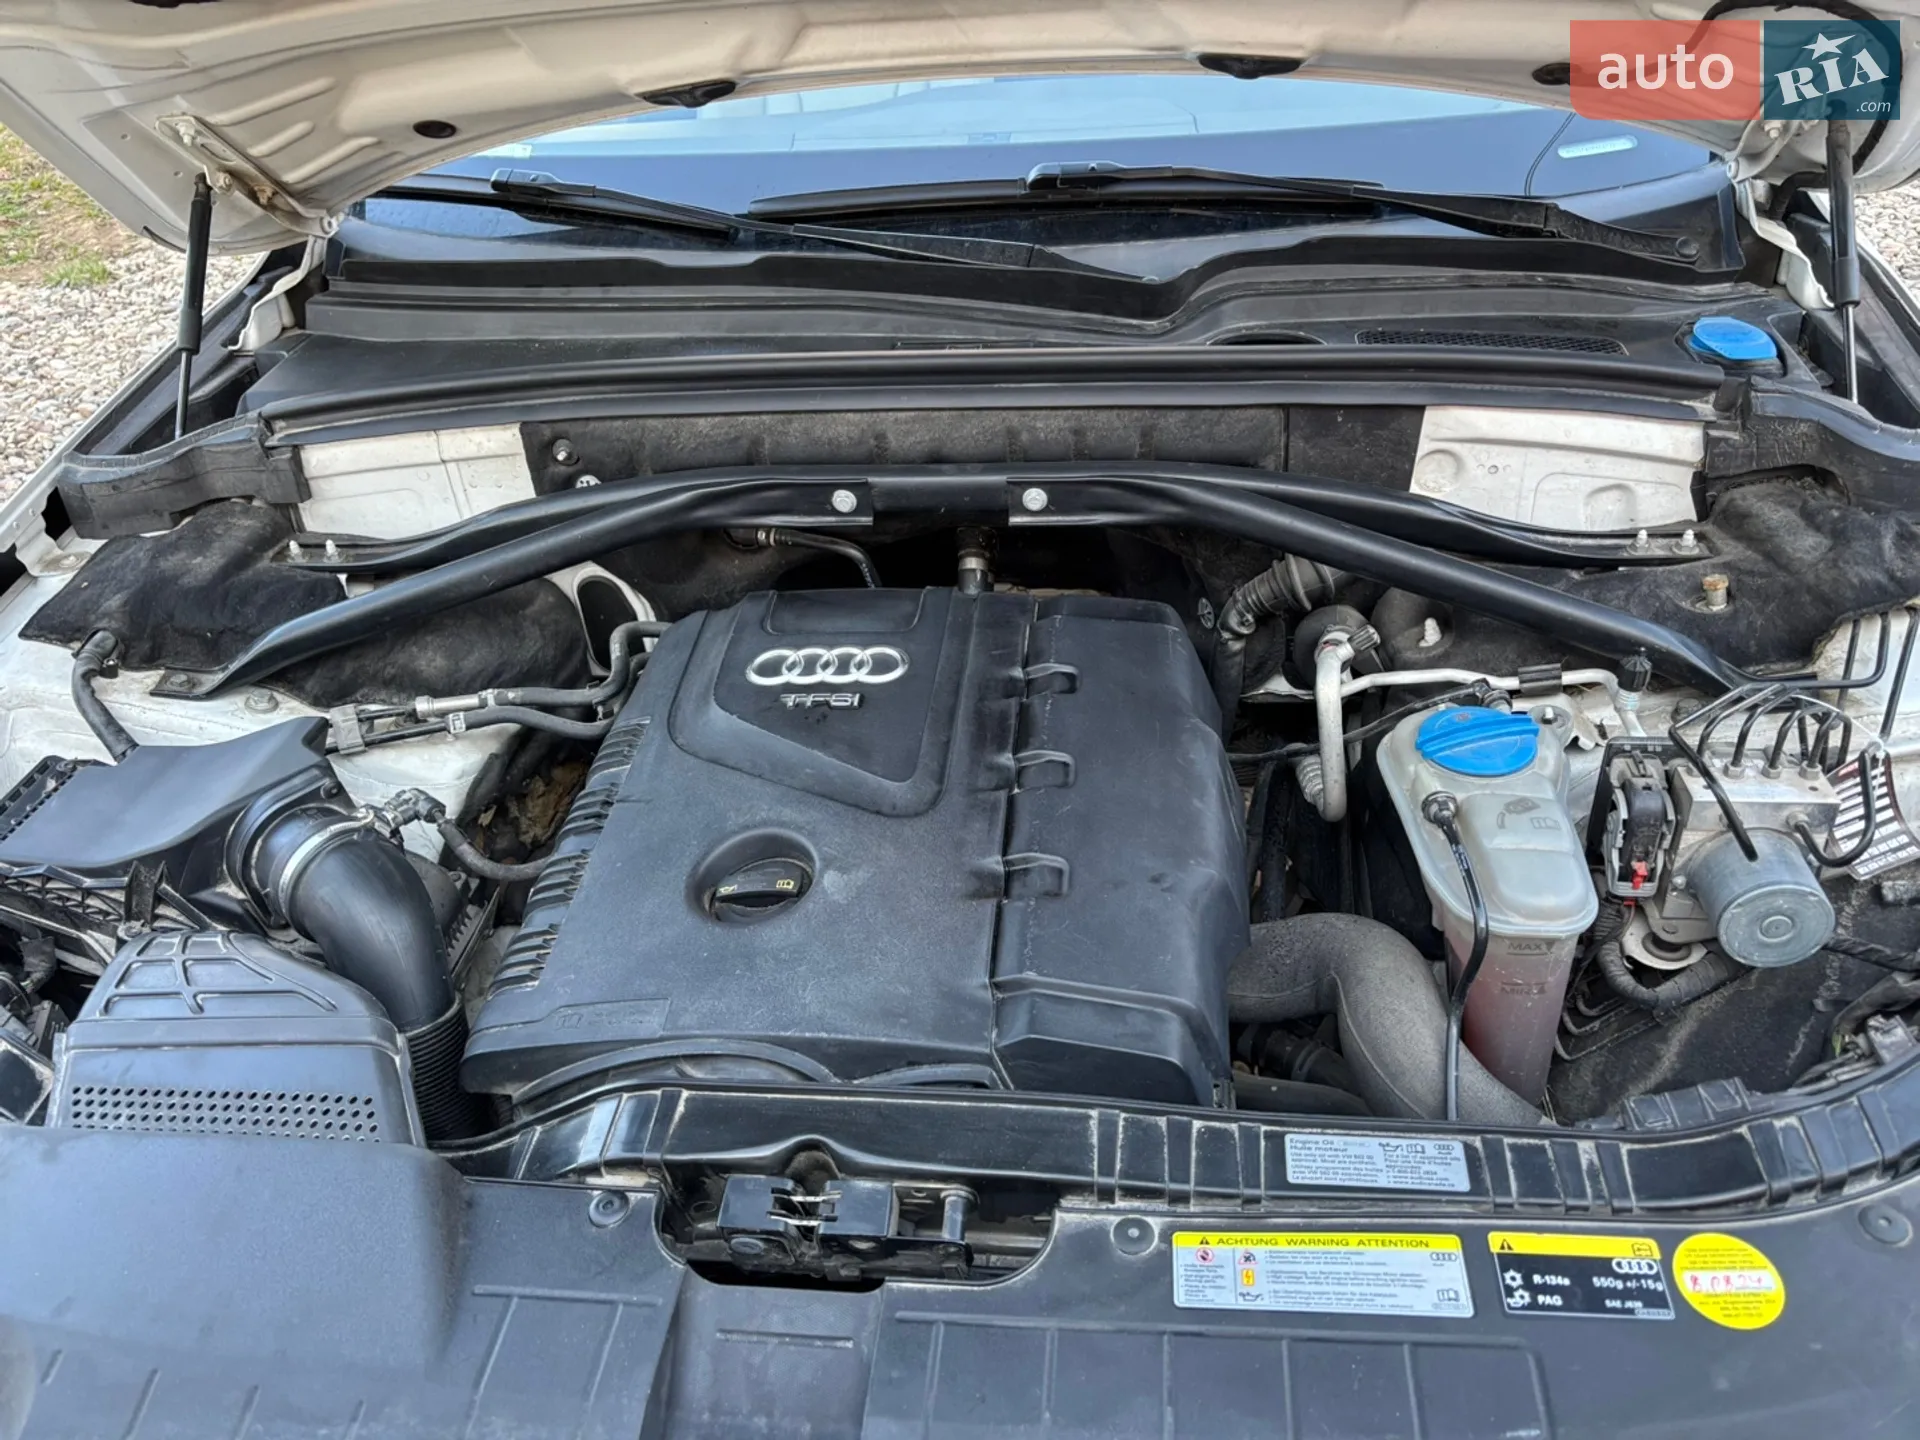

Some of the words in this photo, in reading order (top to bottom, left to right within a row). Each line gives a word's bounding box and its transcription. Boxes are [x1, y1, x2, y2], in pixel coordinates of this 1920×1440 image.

[780, 693, 861, 709] TFSI
[1508, 942, 1542, 951] MAX
[1217, 1237, 1279, 1246] ACHTUNG
[1286, 1238, 1349, 1247] WARNING
[1357, 1239, 1429, 1248] ATTENTION
[1532, 1273, 1571, 1287] R-134a
[1592, 1276, 1625, 1291] 550g
[1537, 1293, 1564, 1307] PAG
